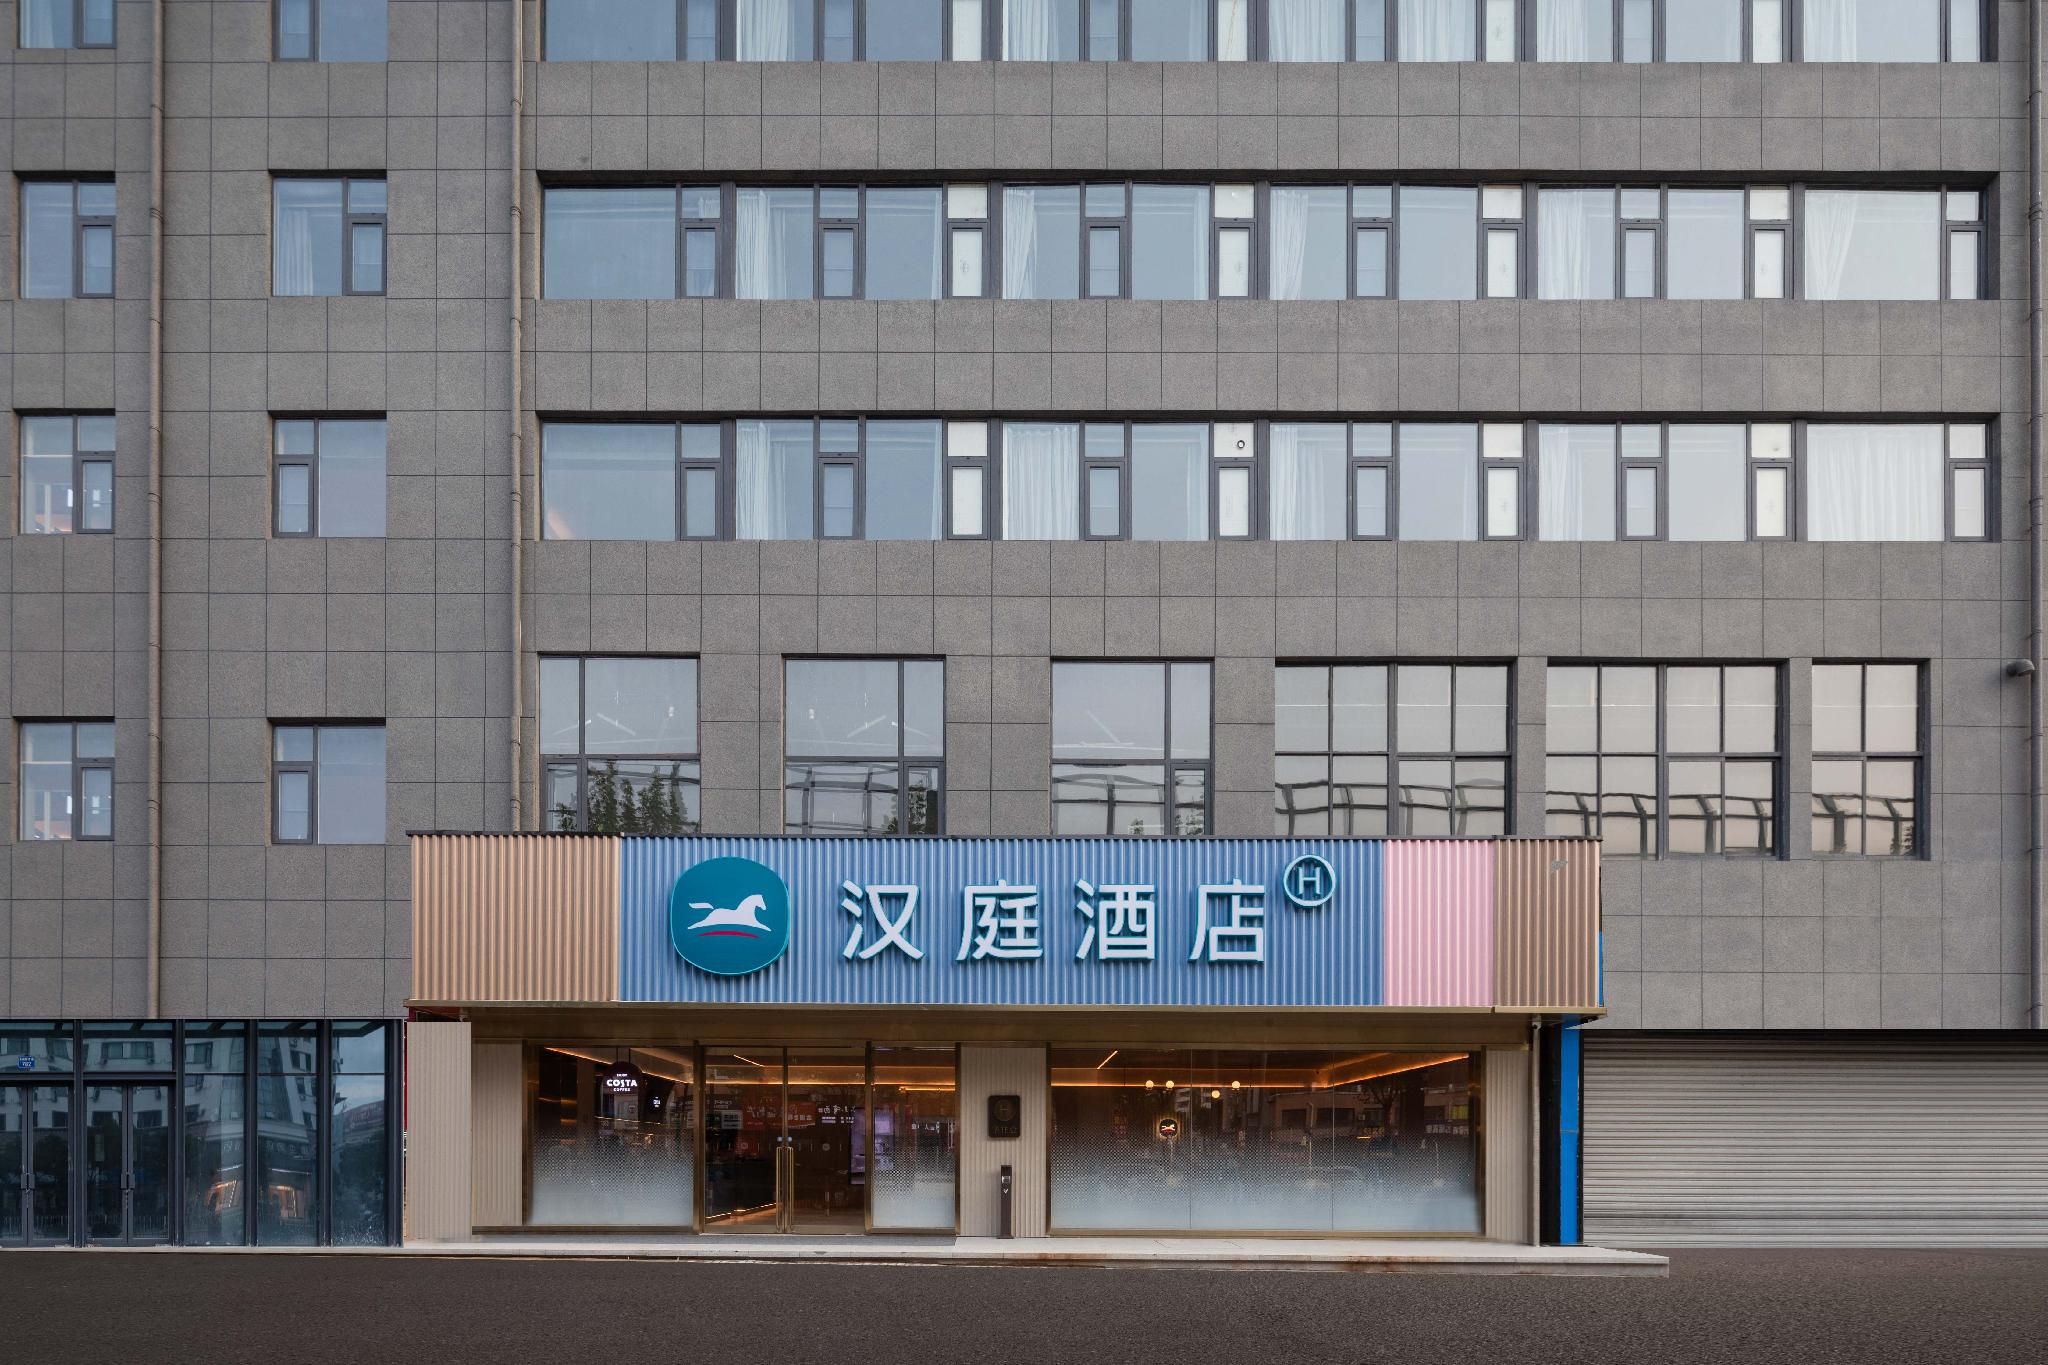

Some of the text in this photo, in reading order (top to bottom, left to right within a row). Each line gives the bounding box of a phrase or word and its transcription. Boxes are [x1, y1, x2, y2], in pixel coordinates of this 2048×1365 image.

[842, 879, 1266, 962] 汉庭酒店
[606, 1079, 638, 1087] COSTA
